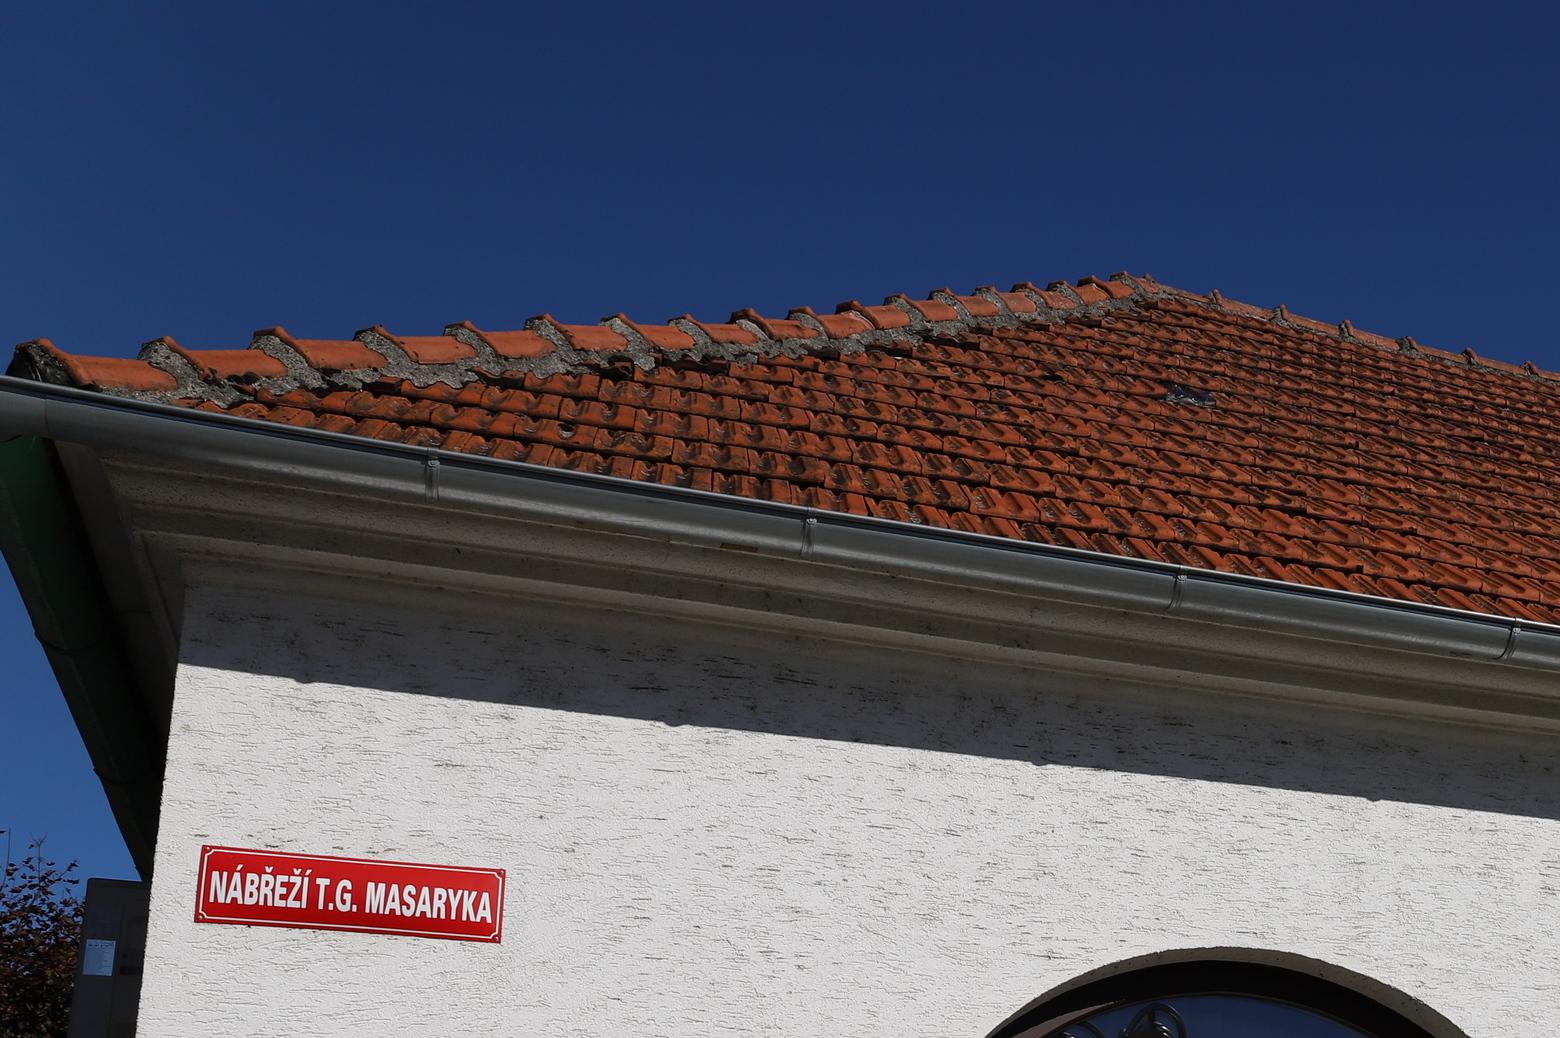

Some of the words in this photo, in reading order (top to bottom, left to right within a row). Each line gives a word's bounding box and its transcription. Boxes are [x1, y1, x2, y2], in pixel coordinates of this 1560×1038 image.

[208, 863, 312, 909] NÁBŘEŽÍ
[315, 877, 358, 913] T.G.
[364, 881, 493, 924] MASARYKA
